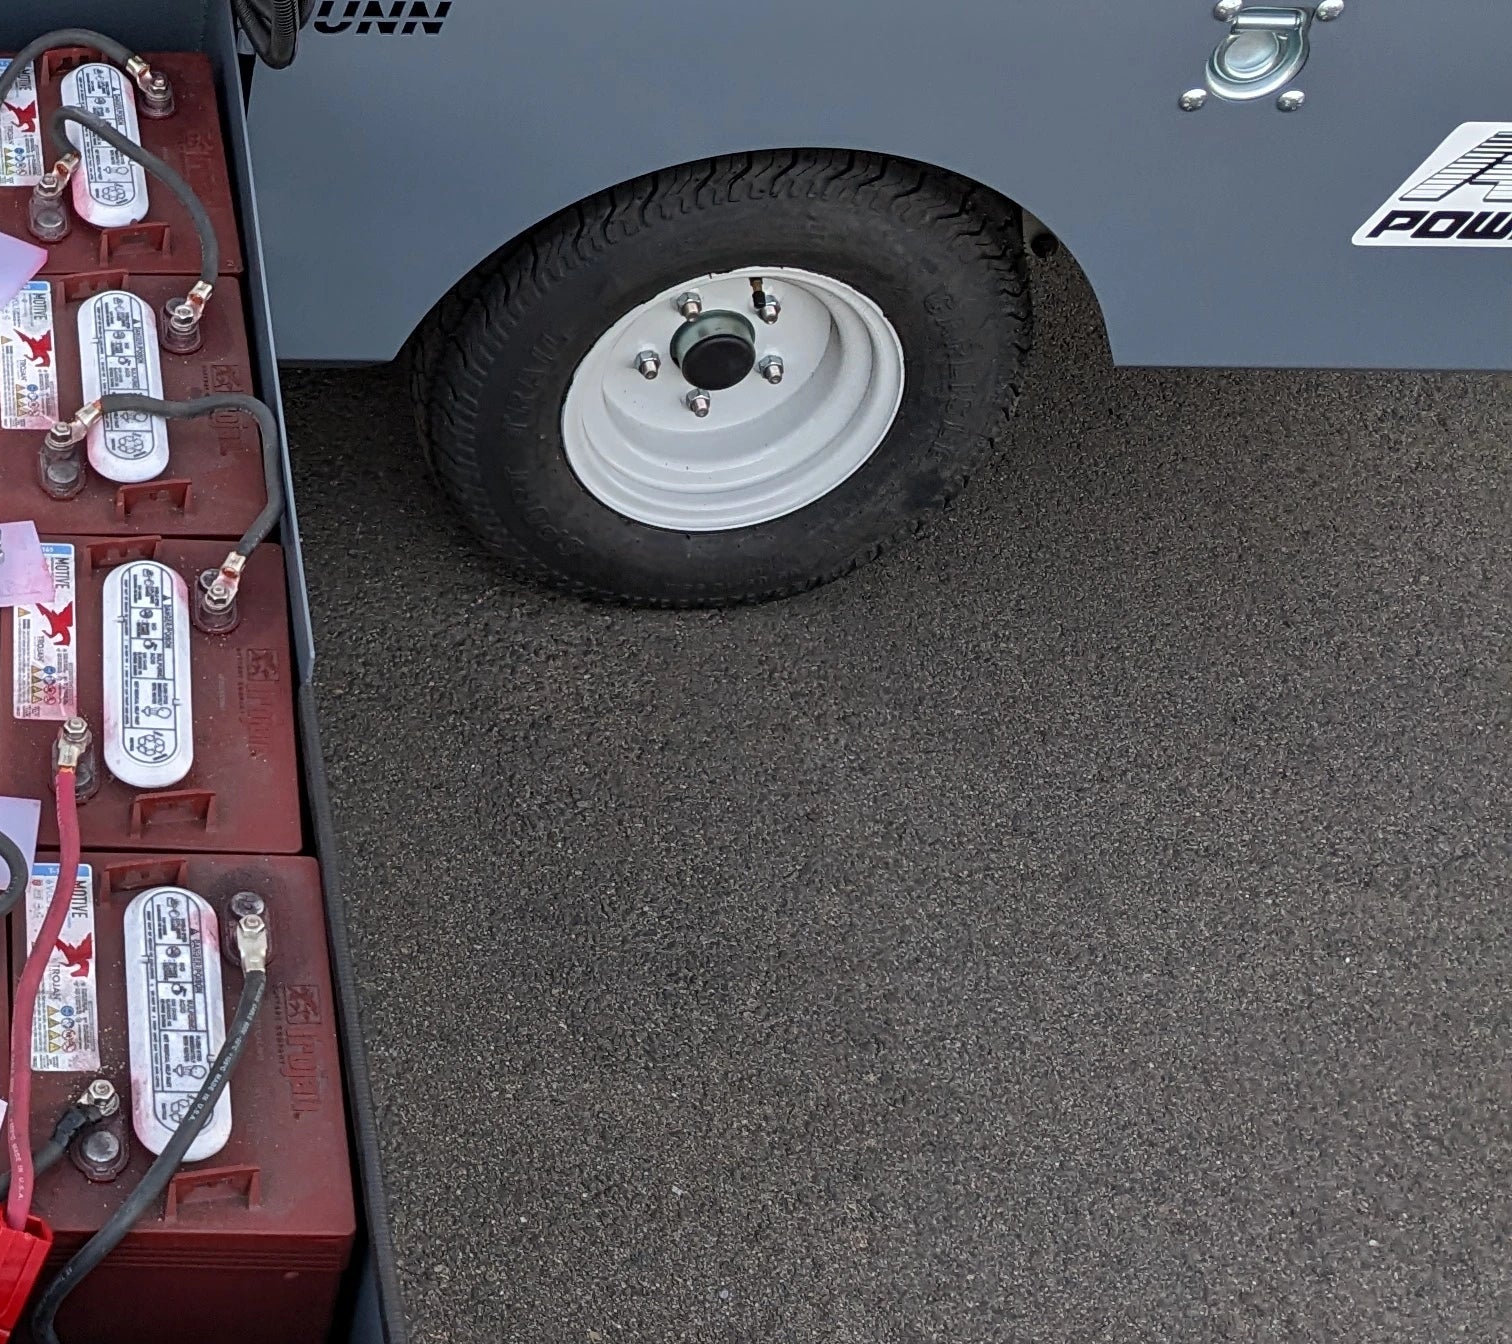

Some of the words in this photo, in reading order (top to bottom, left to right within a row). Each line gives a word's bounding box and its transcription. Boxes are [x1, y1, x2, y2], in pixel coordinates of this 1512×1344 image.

[314, 0, 453, 35] UNN
[1365, 210, 1512, 240] POW
[32, 293, 48, 320] MOTIVE
[55, 557, 70, 589] MOTIVE
[36, 635, 45, 662] TROJAN
[71, 880, 89, 918] MOTIVE
[51, 965, 62, 1000] TROJAN
[208, 1073, 222, 1091] MADE
